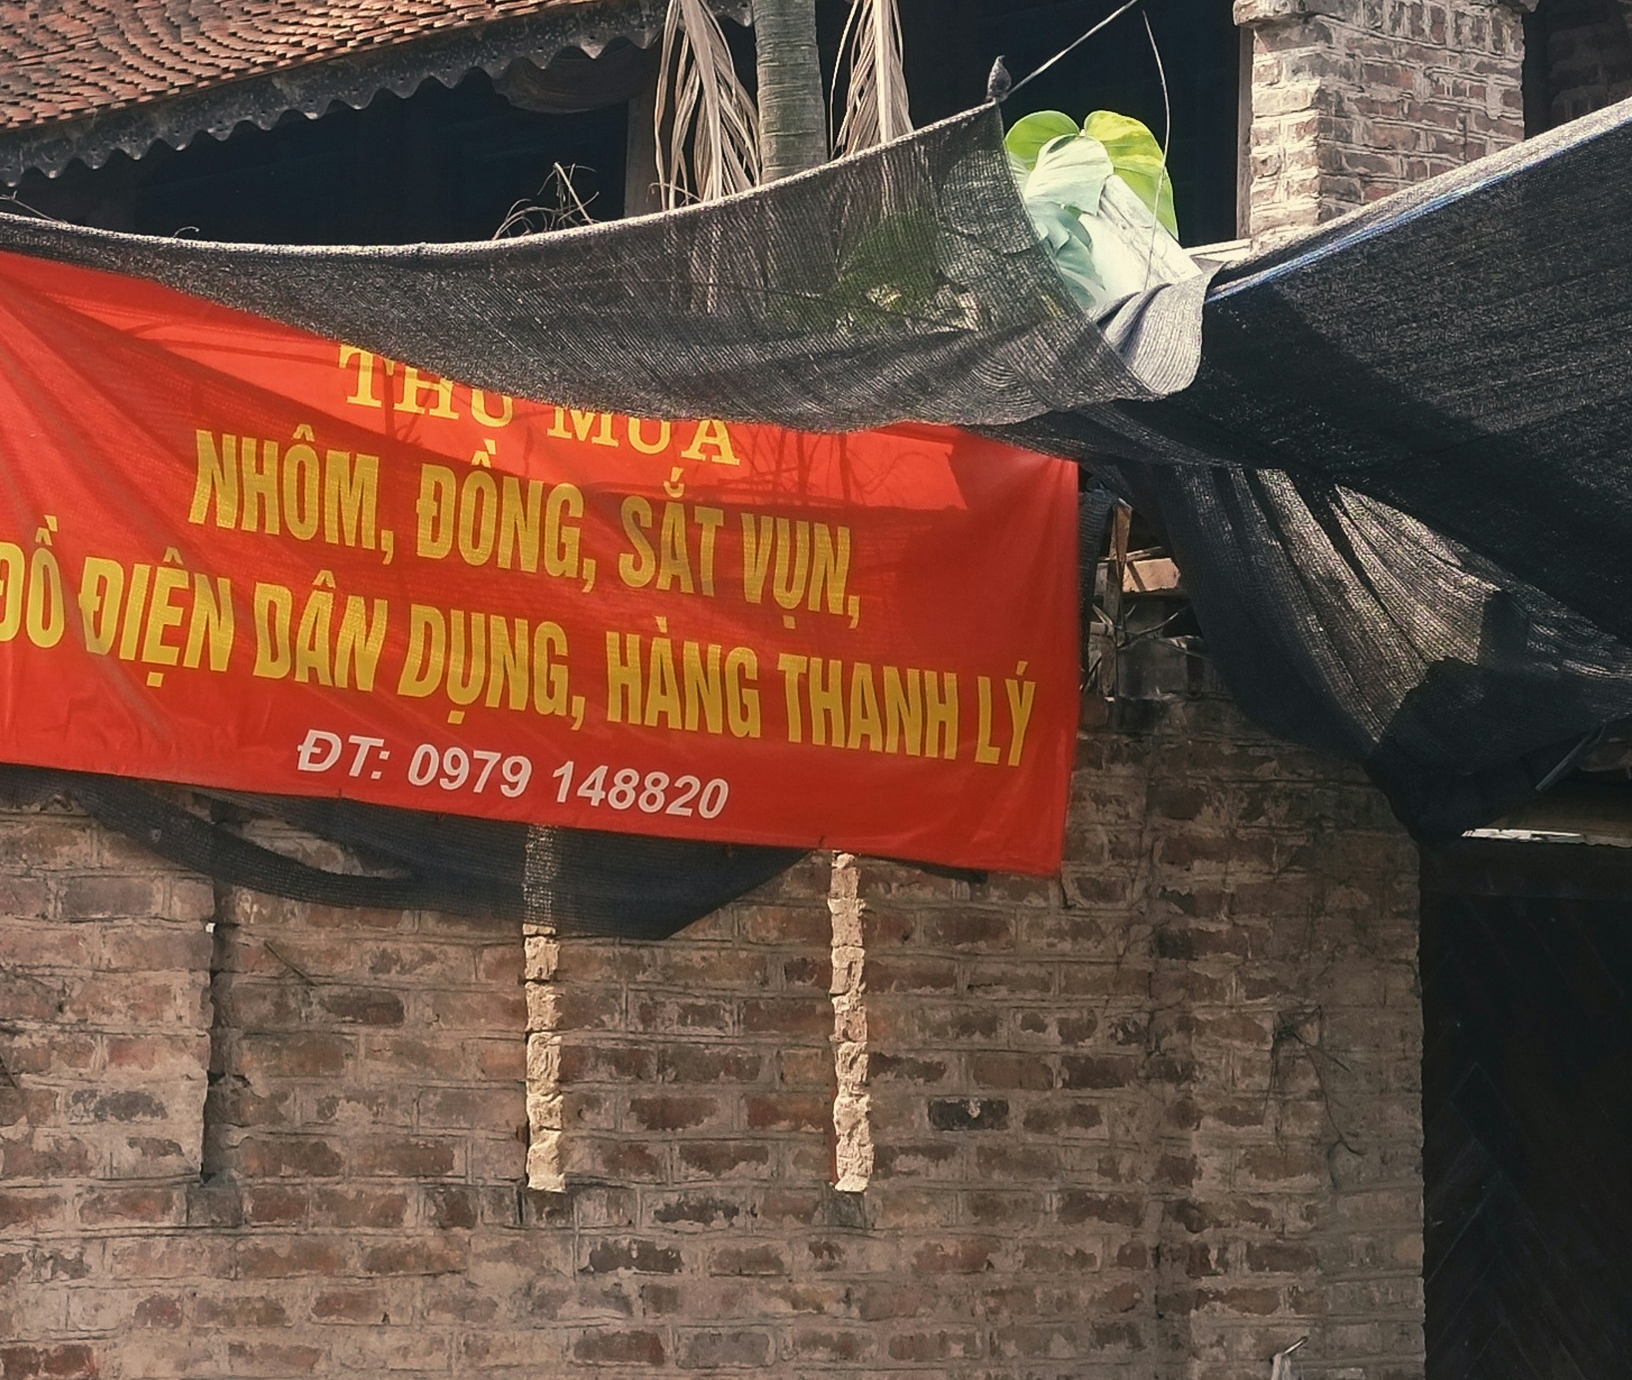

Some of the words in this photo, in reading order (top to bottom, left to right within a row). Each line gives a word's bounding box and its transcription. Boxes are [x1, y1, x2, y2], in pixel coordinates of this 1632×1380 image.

[338, 343, 514, 428] THU
[188, 423, 395, 565] NHÔM,
[416, 439, 597, 592] ĐỒNG,
[618, 468, 725, 597] SẮT
[739, 511, 861, 629] VỤN,
[78, 546, 236, 688] ĐIỆN
[252, 569, 389, 692] DÂN
[397, 603, 586, 731] DỤNG,
[605, 616, 762, 739] HÀNG
[776, 653, 958, 761] THANH
[974, 660, 1036, 767] LÝ
[297, 728, 391, 780] ĐT:
[407, 743, 533, 798] 0979
[551, 760, 731, 819] 148820
